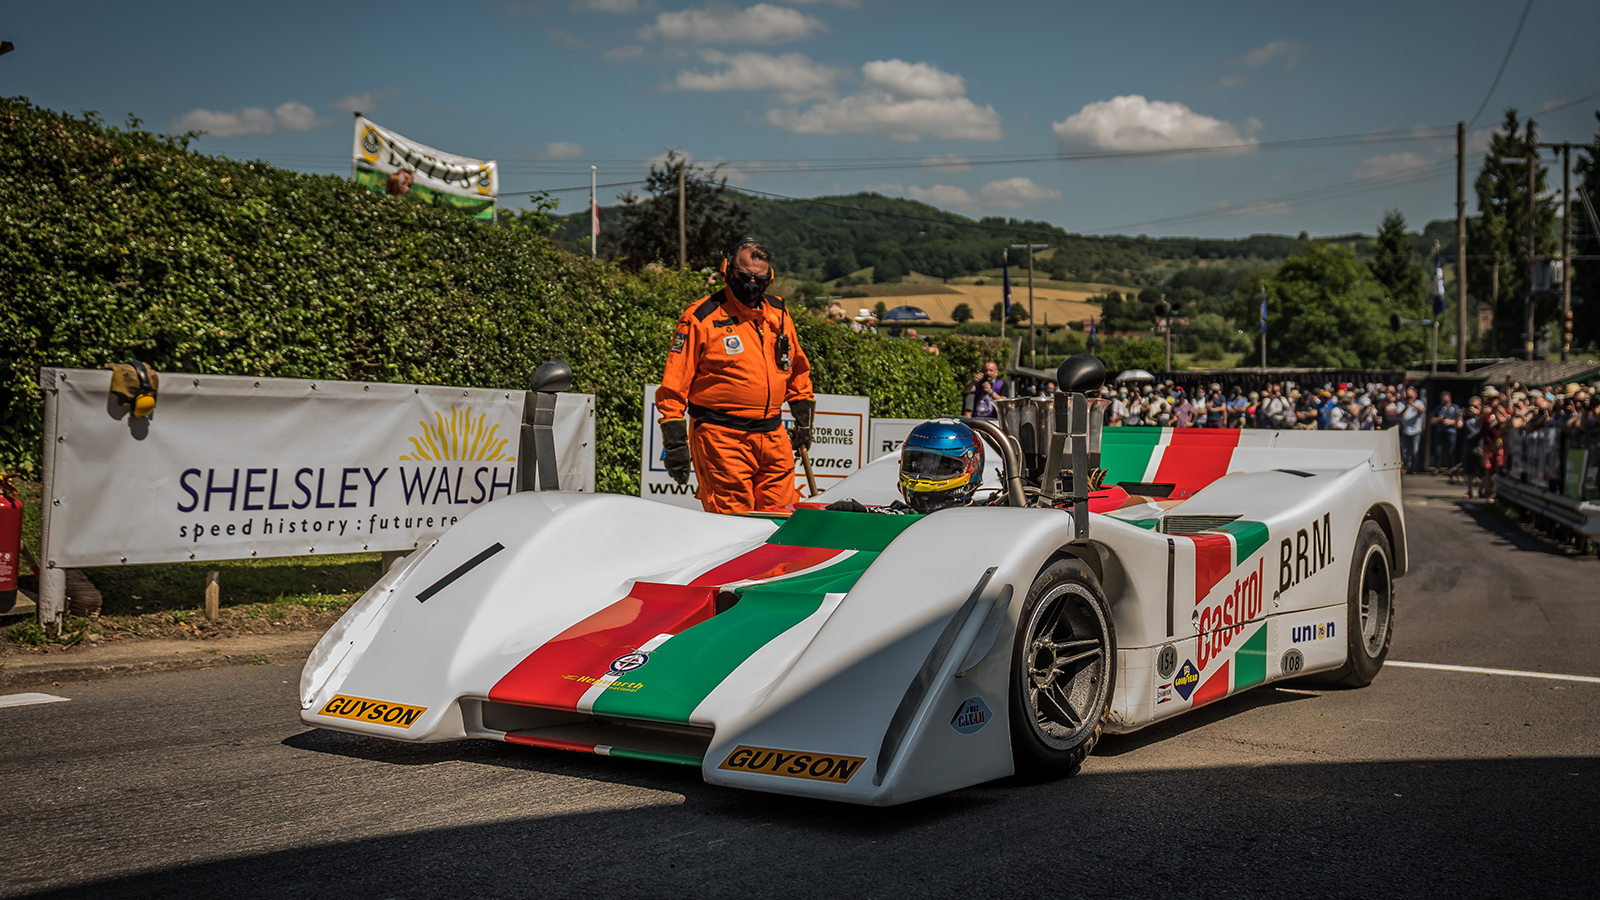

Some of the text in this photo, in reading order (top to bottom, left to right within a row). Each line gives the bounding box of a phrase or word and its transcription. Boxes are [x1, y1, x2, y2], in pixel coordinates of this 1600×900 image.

[811, 427, 854, 437] OTOR OILS
[177, 466, 515, 513] SHELSLEY WALSH
[179, 516, 252, 542] speed
[263, 516, 349, 536] history
[369, 514, 434, 535] future
[441, 516, 458, 527] re
[1278, 512, 1336, 595] B.R.M.
[1196, 555, 1265, 672] Castrol
[1161, 651, 1174, 671] 154
[1284, 655, 1300, 671] 108
[576, 675, 644, 689] Hepworth
[325, 697, 422, 726] GUYSON
[727, 749, 860, 779] GUYSON
